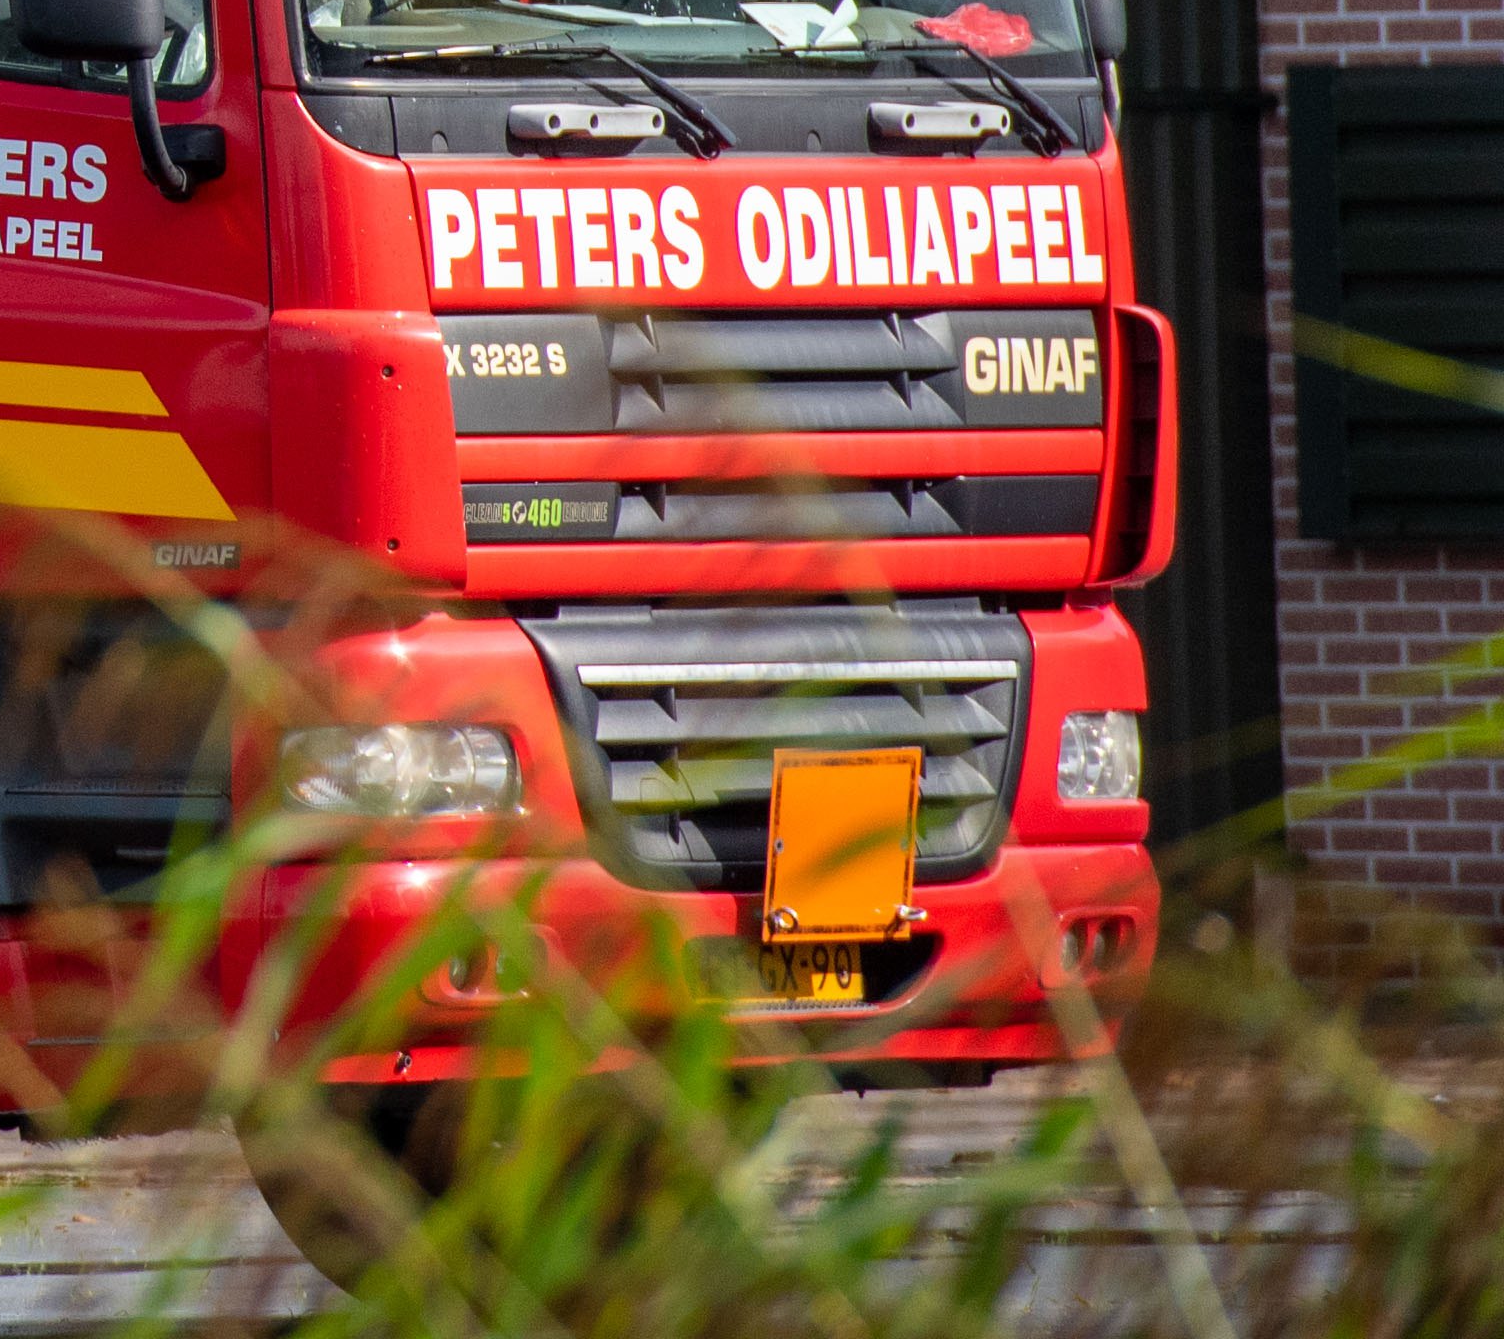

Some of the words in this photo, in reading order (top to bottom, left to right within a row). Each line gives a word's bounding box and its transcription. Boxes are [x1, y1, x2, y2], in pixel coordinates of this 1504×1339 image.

[426, 185, 705, 291] PETERS
[735, 184, 1104, 291] ODILIAPEEL
[470, 343, 541, 376] 3232
[546, 342, 568, 376] S
[964, 336, 1096, 394] GINAF
[528, 498, 562, 527] 460
[154, 544, 236, 566] GINAF
